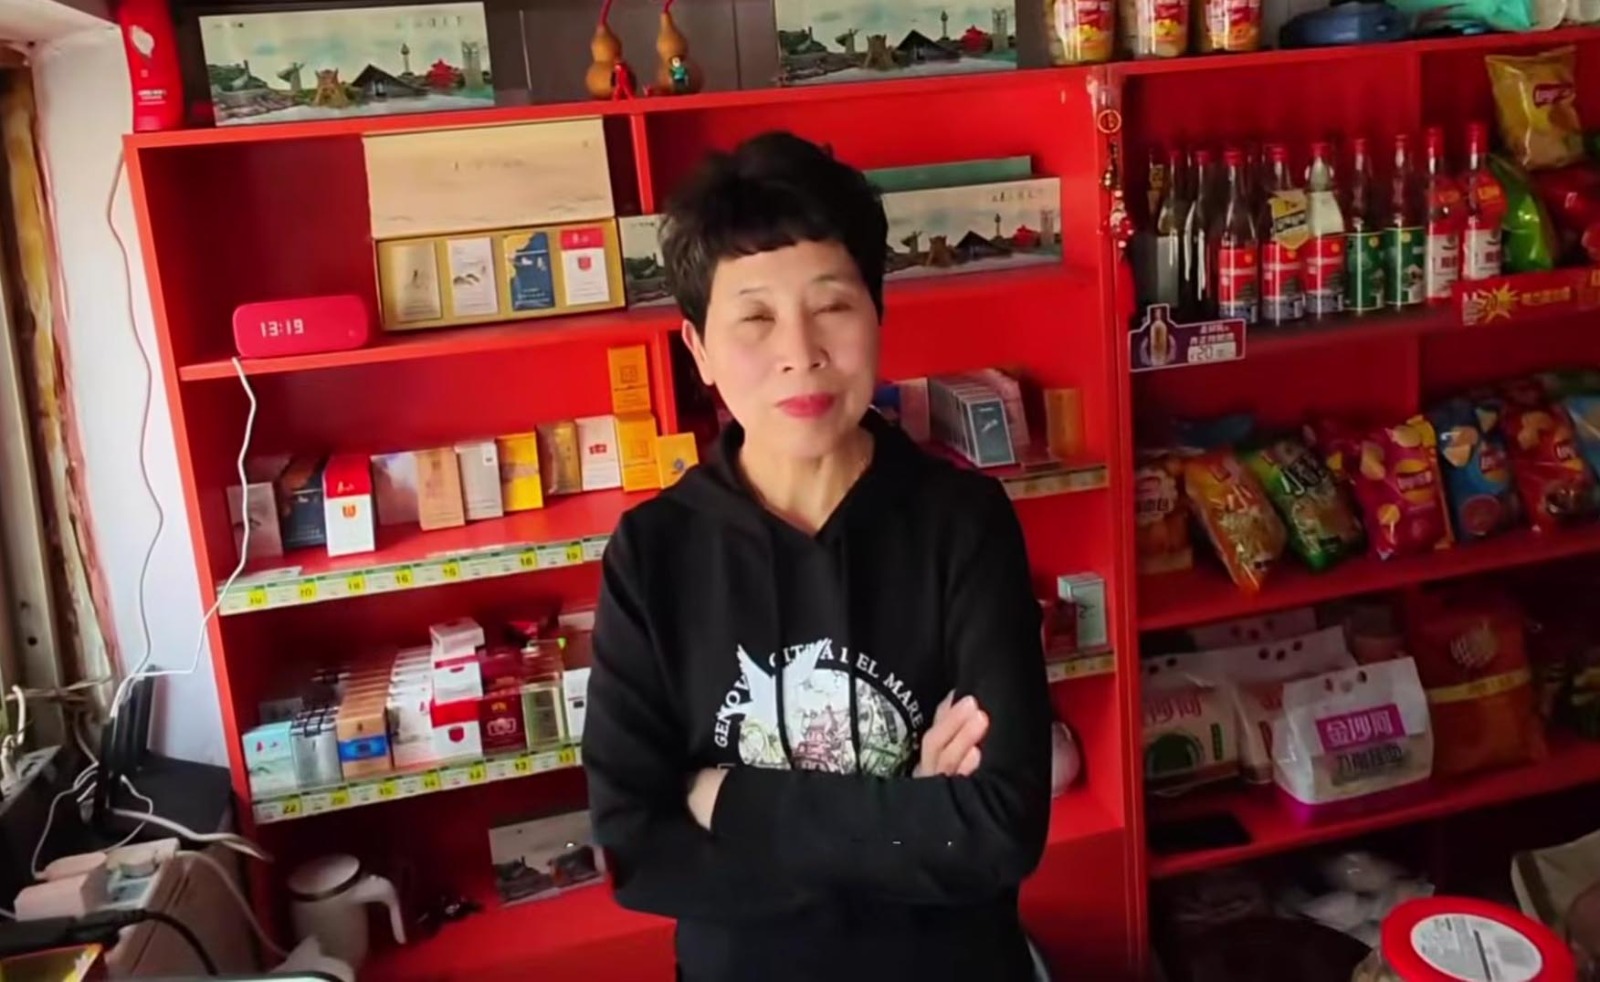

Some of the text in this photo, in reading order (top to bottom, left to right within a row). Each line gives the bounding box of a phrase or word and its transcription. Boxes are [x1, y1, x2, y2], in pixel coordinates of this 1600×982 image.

[260, 318, 304, 338] 13:19
[714, 674, 750, 748] GENOV
[882, 671, 924, 729] MARE
[1327, 710, 1393, 747] 金沙河
